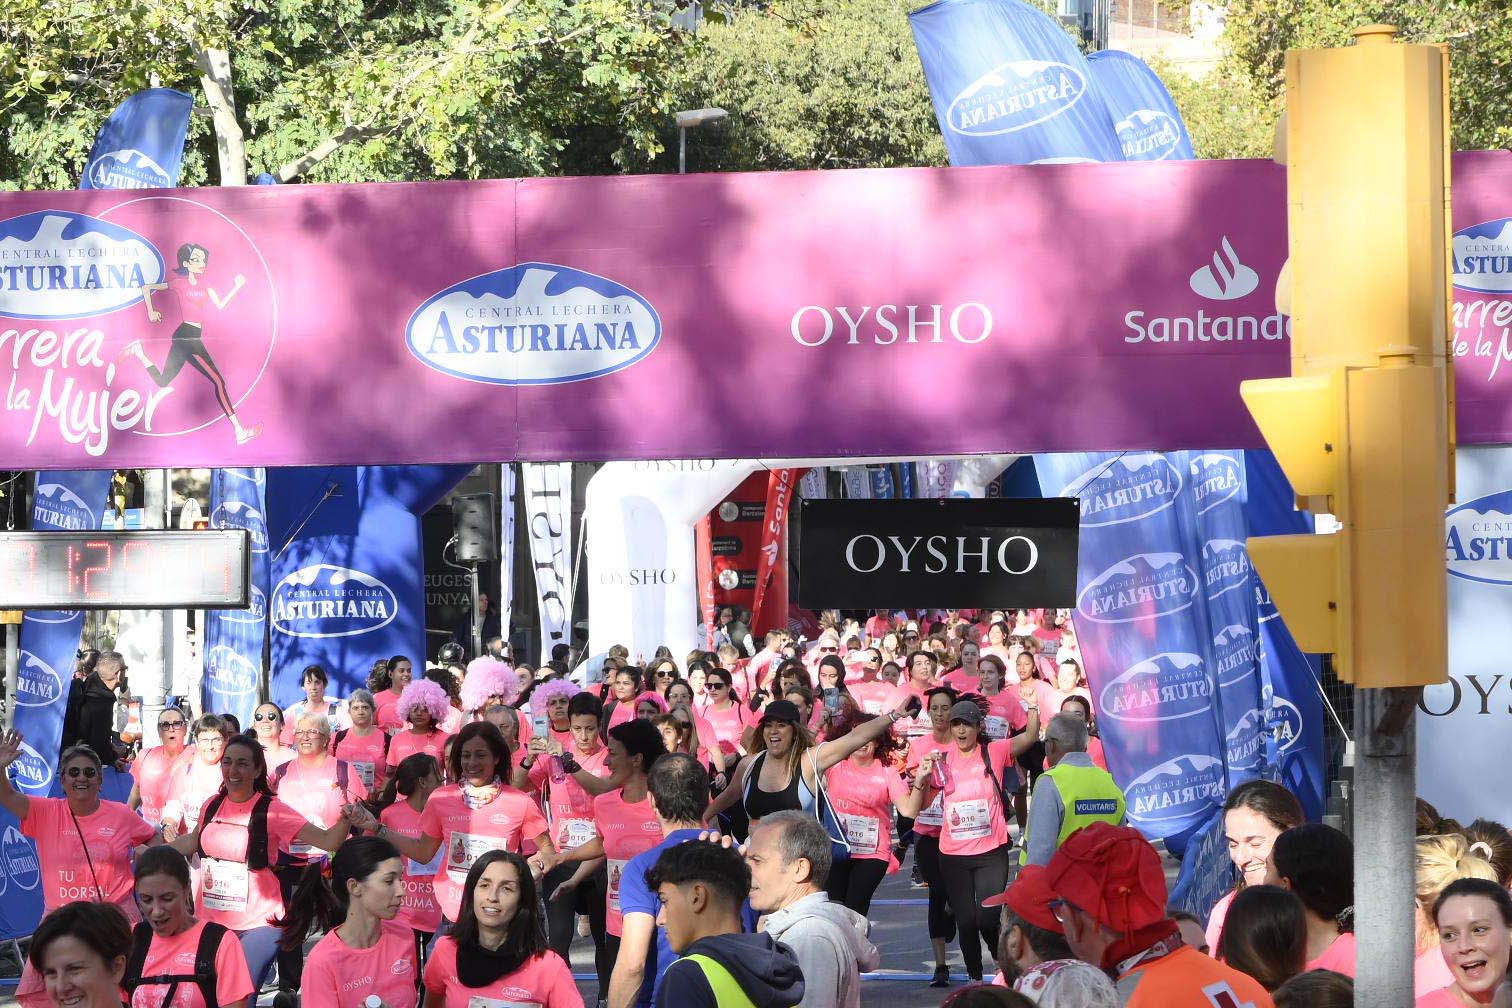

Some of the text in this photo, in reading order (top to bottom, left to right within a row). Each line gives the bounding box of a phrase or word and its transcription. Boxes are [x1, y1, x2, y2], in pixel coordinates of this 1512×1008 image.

[67, 246, 140, 258] LECHERA
[466, 303, 633, 318] CENTRAL LECHERA
[426, 311, 641, 354] ASTURIANA
[791, 302, 993, 347] OYSHO
[1475, 329, 1493, 357] la
[6, 371, 31, 410] la
[26, 361, 176, 457] Mujer
[845, 535, 1039, 575] OYSHO
[600, 569, 676, 585] OYSHO
[288, 588, 384, 598] CENTRAL LECHERA
[274, 594, 388, 622] ASTURIANA
[1417, 675, 1512, 717] OY
[1076, 802, 1116, 812] VOLUNTARIS
[961, 815, 975, 823] 016
[59, 870, 74, 883] TU
[59, 886, 110, 899] DORSAL
[343, 976, 372, 992] OYSHO
